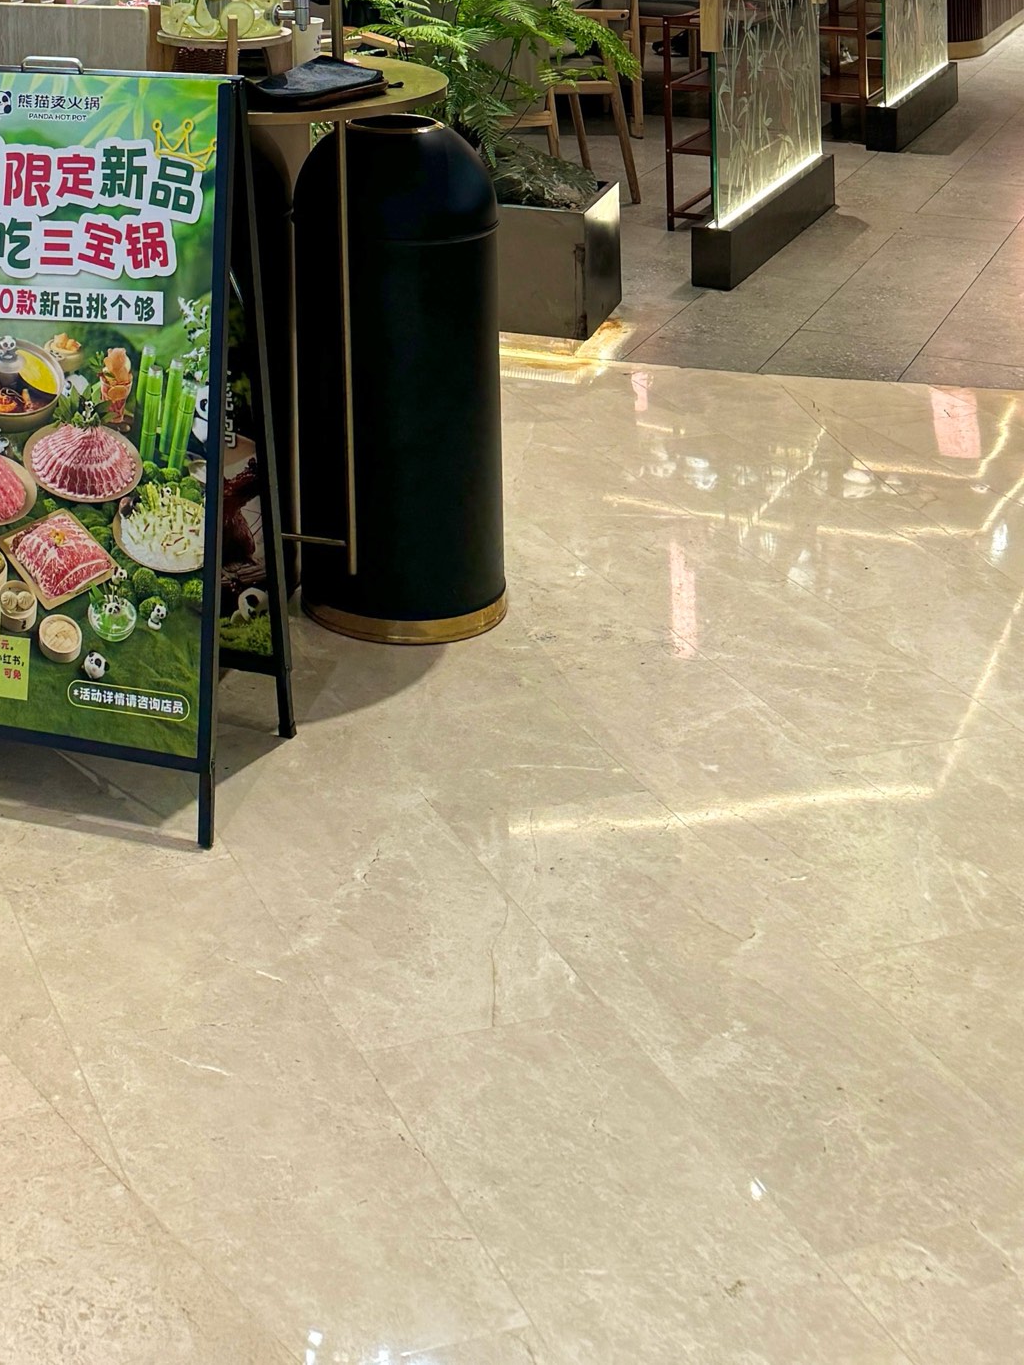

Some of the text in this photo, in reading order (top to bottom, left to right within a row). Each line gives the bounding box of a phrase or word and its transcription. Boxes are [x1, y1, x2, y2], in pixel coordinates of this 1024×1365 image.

[18, 93, 101, 111] 熊猫烫火锅
[28, 112, 87, 122] PANDA HOT POT
